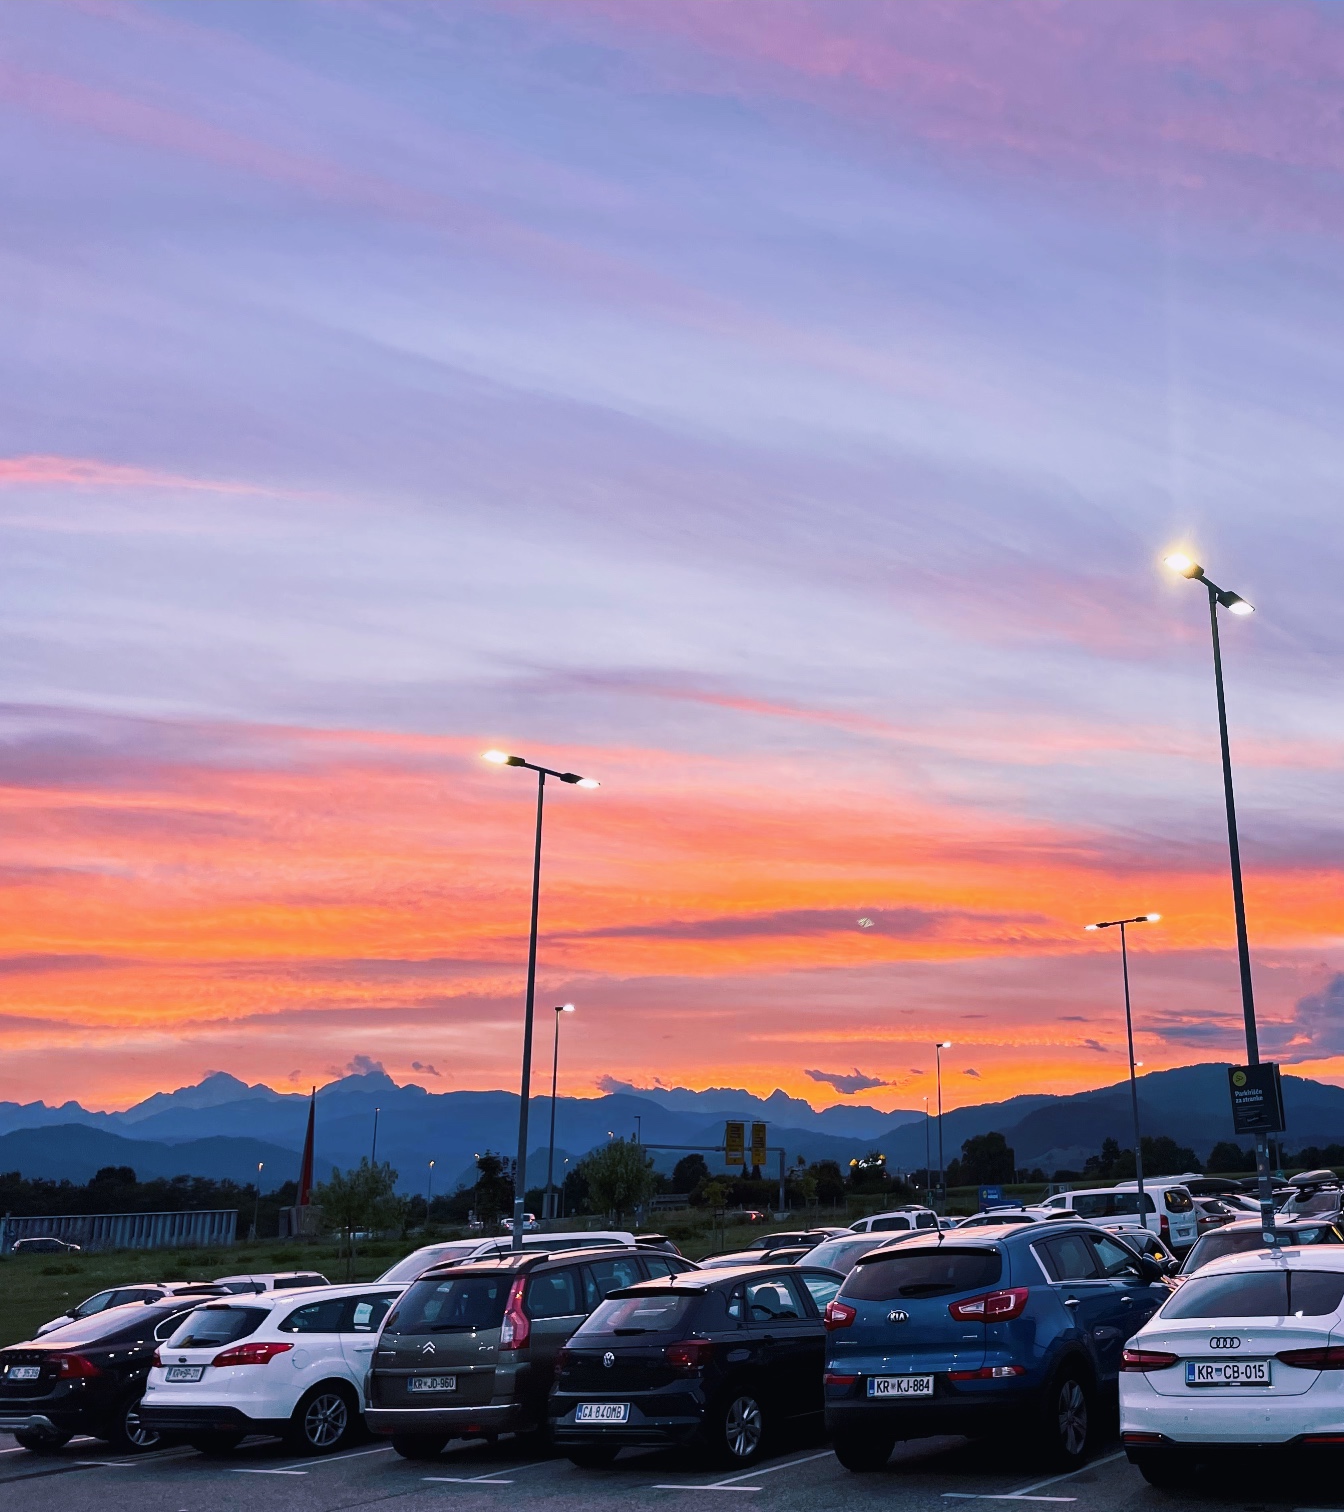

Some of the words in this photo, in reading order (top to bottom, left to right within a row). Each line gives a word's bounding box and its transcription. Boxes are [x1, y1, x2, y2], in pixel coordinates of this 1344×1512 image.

[889, 1311, 906, 1322] KIA
[1197, 1364, 1214, 1380] KR
[1223, 1364, 1265, 1380] CB-015
[413, 1378, 423, 1389] KR
[876, 1380, 890, 1394] KR
[896, 1378, 931, 1393] KJ-884
